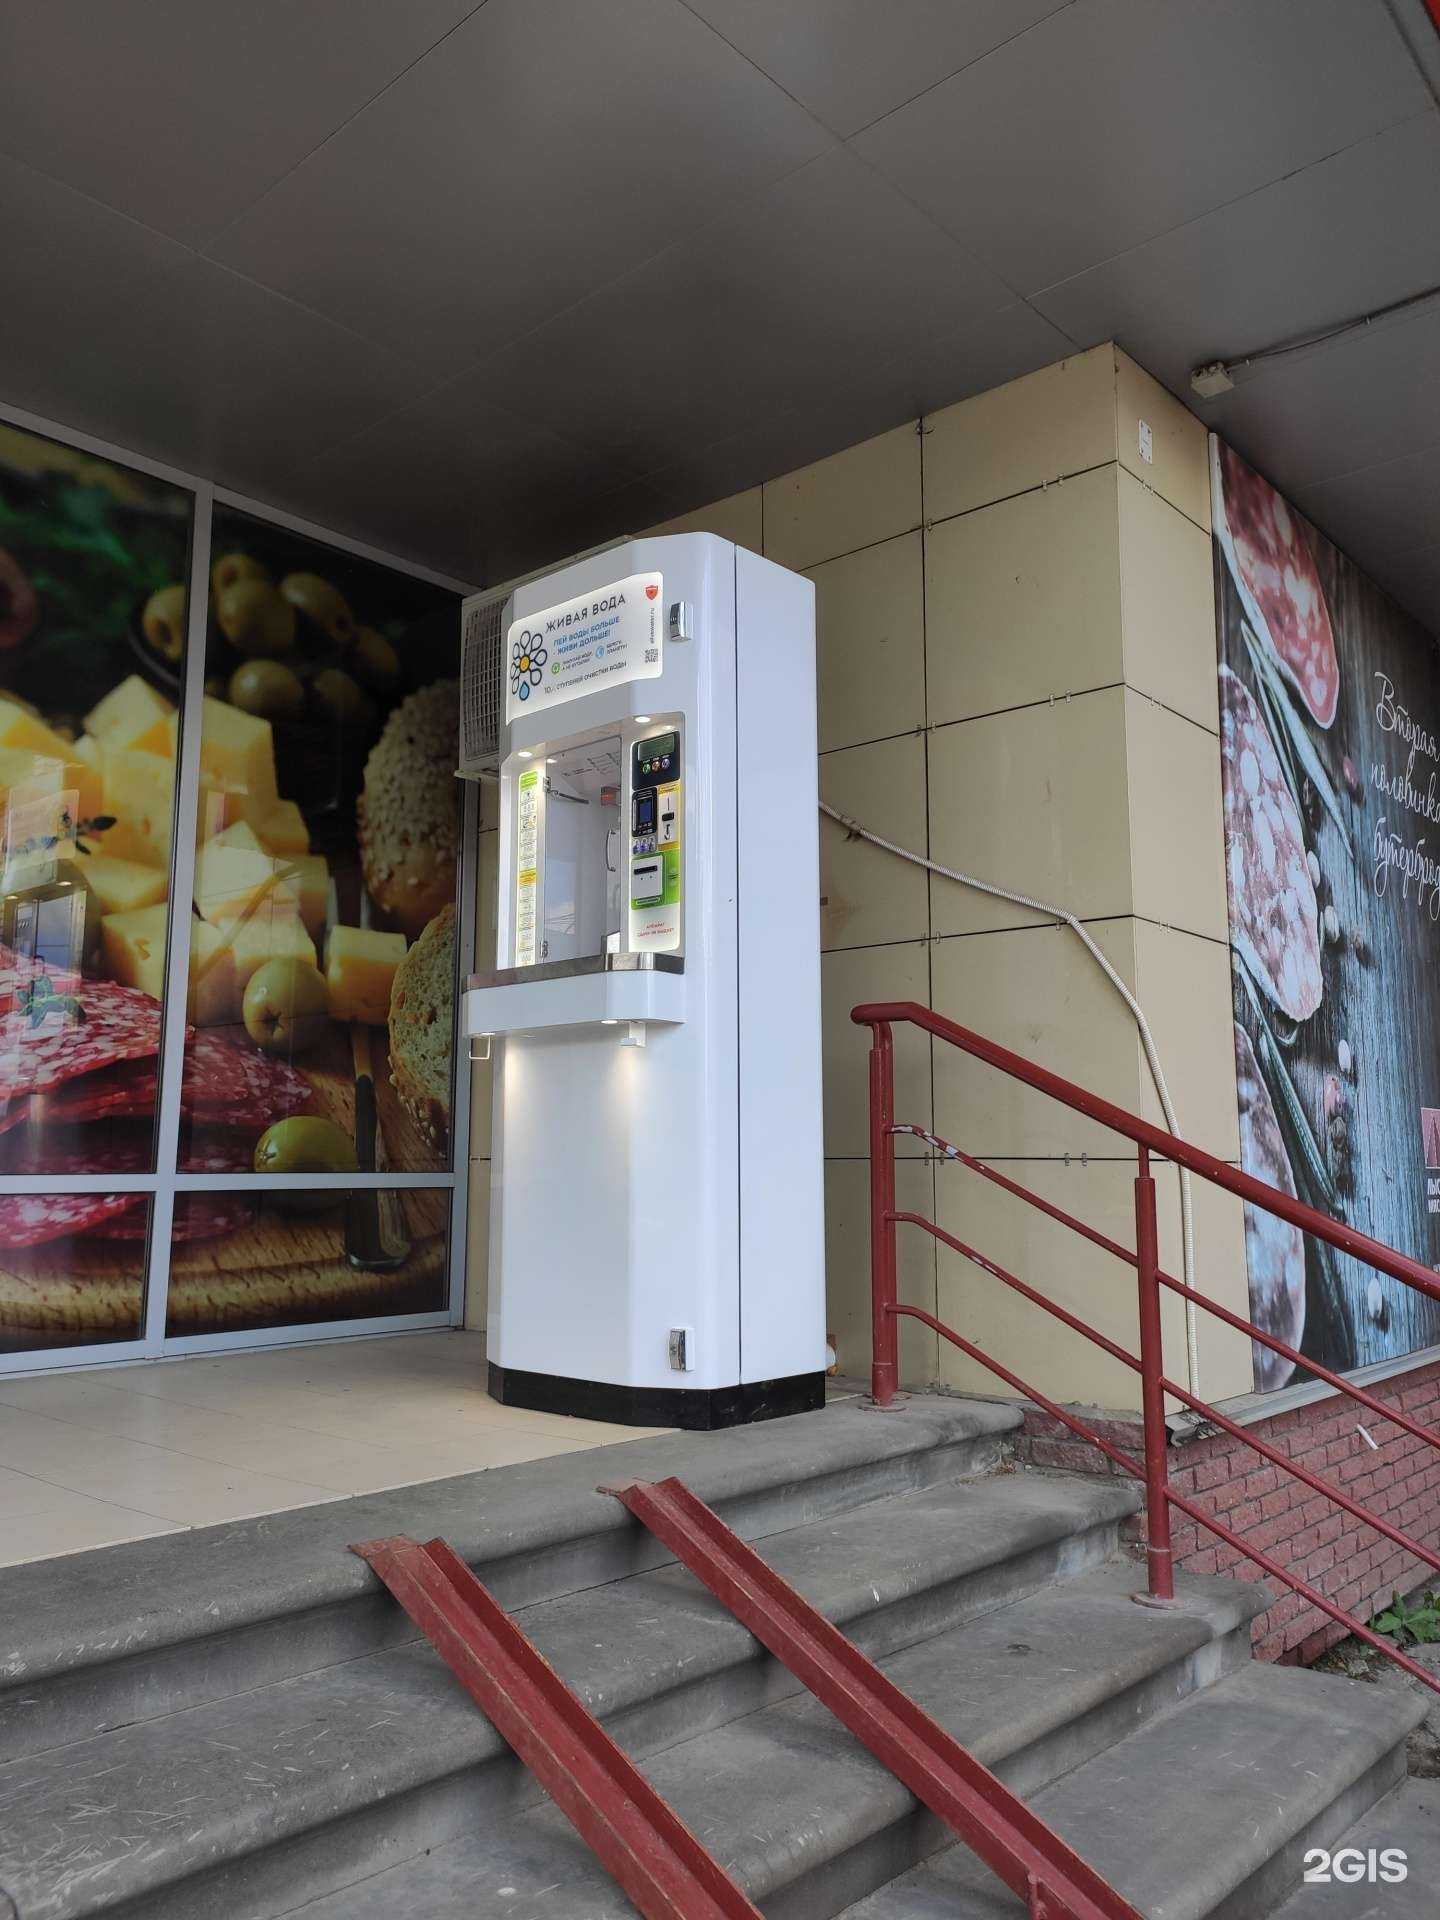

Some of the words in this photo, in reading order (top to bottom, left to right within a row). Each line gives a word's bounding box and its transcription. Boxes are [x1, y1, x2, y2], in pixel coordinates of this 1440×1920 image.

[545, 607, 588, 634] ЖИВАЯ
[592, 593, 626, 616] ВОДА
[553, 634, 568, 647] ПЕЙ
[568, 628, 590, 642] ВОДЫ
[590, 615, 621, 634] БОЛЬШЕ
[1374, 671, 1440, 770] Вторая
